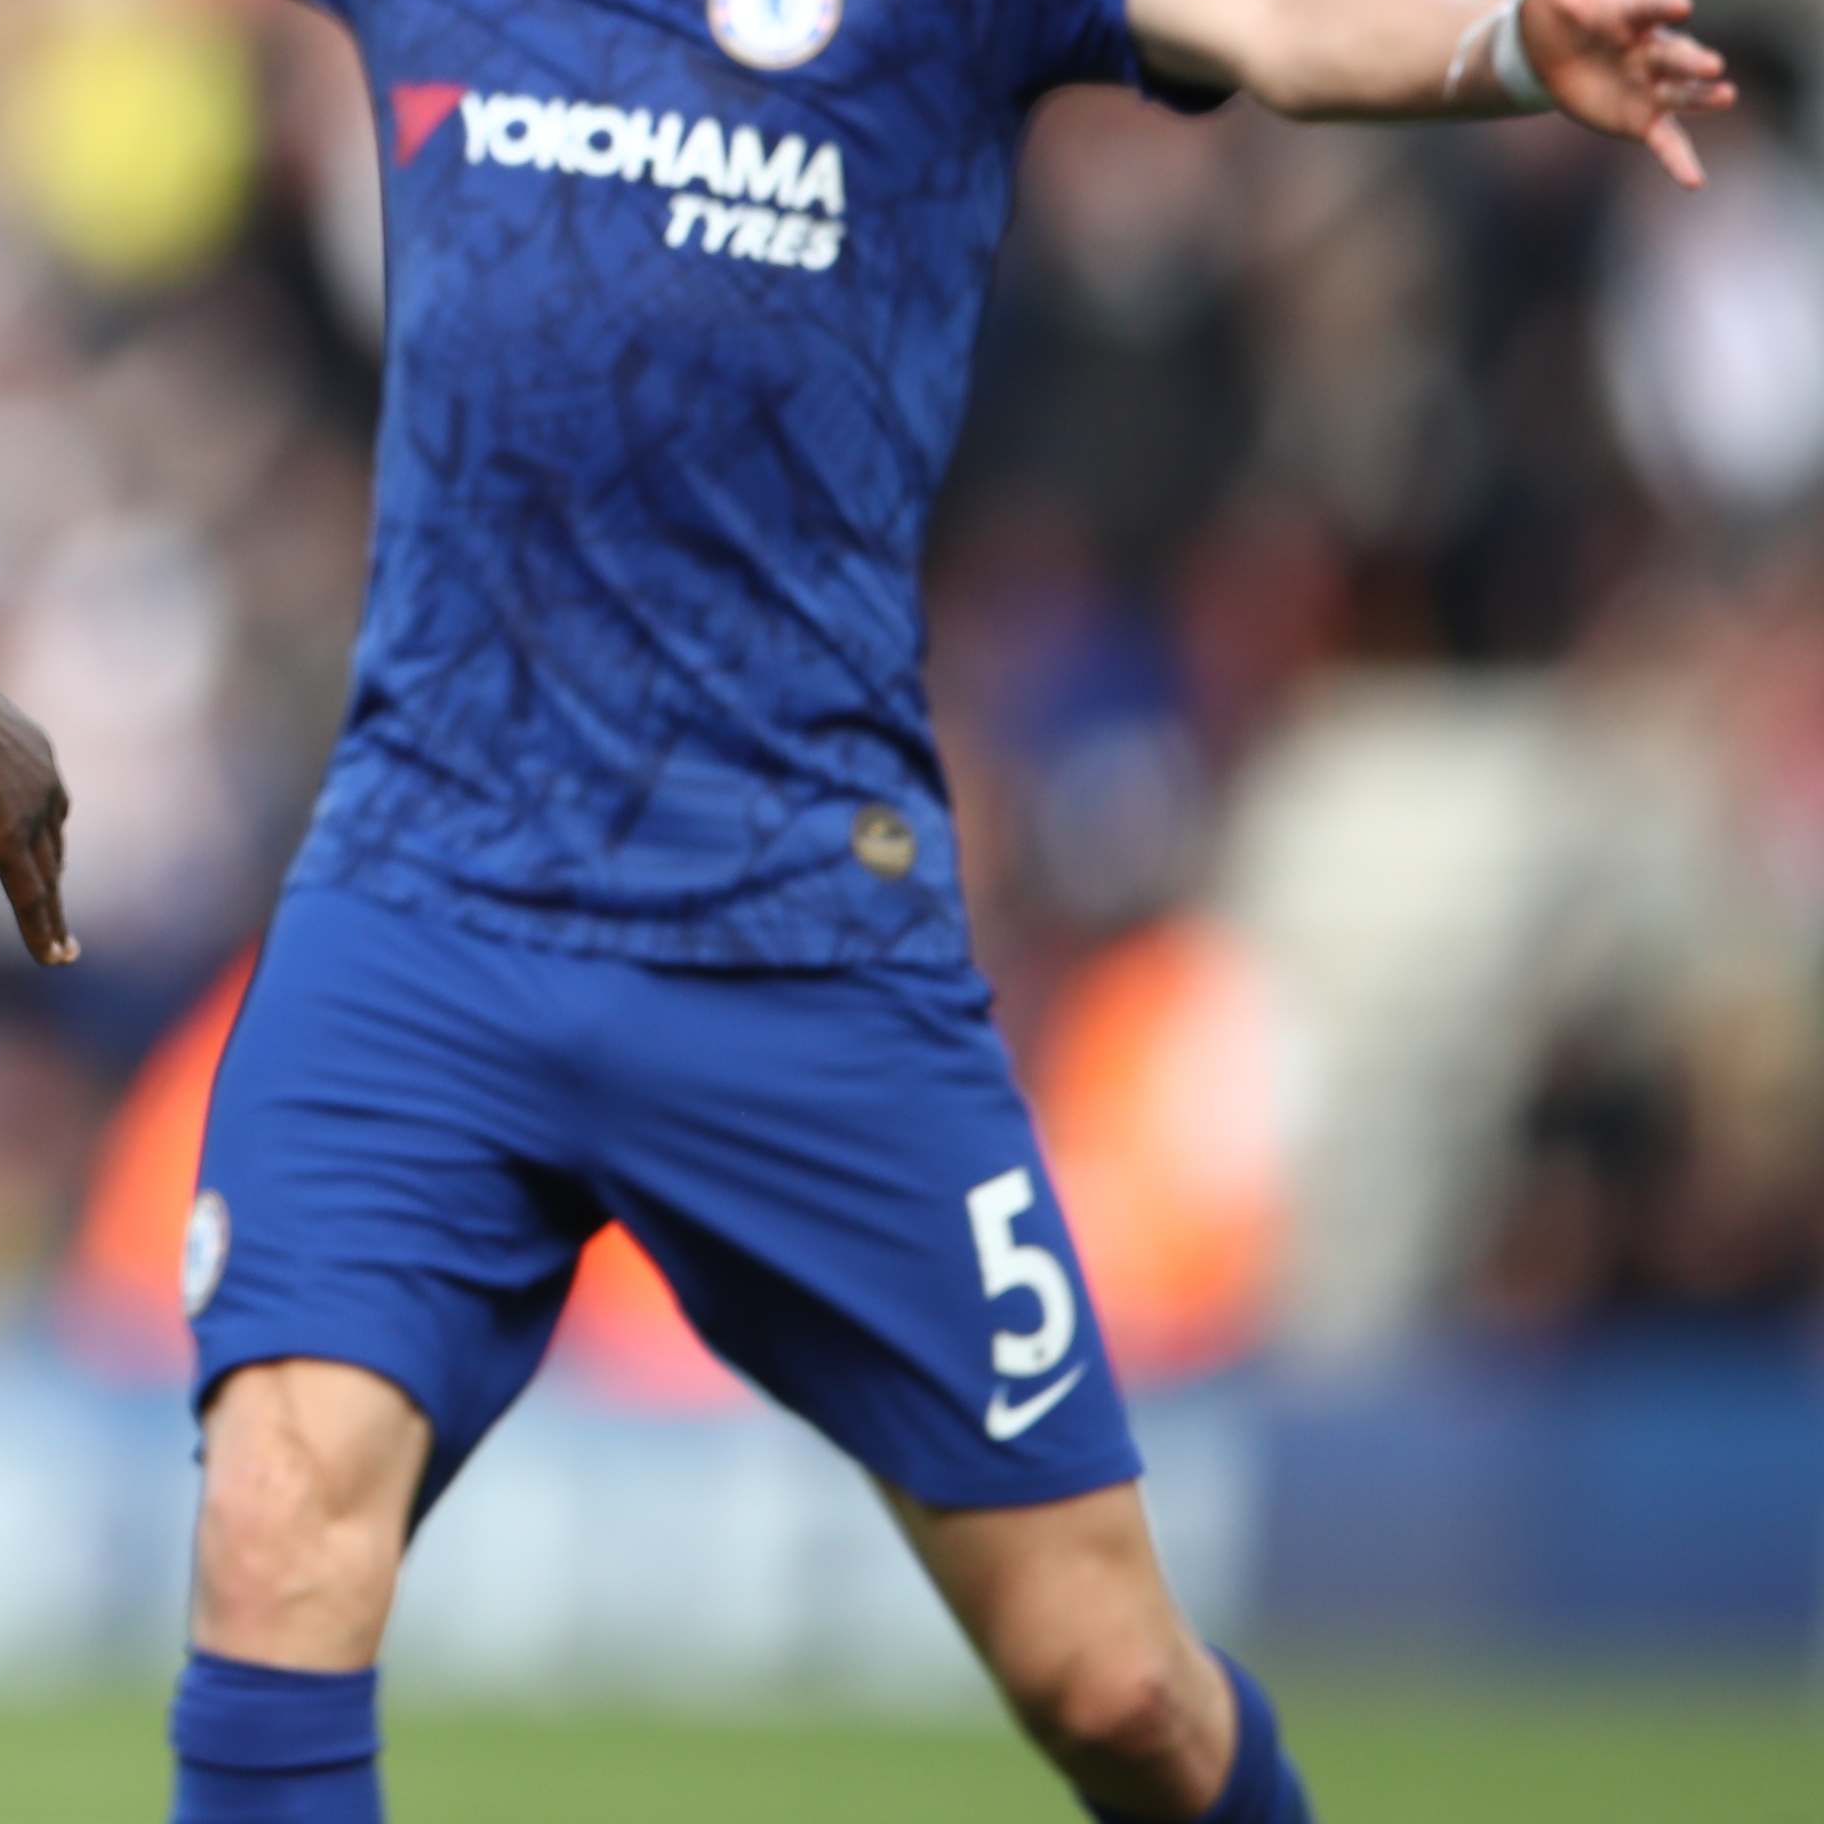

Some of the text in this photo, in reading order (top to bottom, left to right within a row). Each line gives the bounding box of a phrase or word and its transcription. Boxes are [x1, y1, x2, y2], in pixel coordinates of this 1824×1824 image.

[458, 88, 846, 217] YOKOHAMA
[664, 192, 846, 273] TYRES
[967, 1166, 1076, 1378] 5
